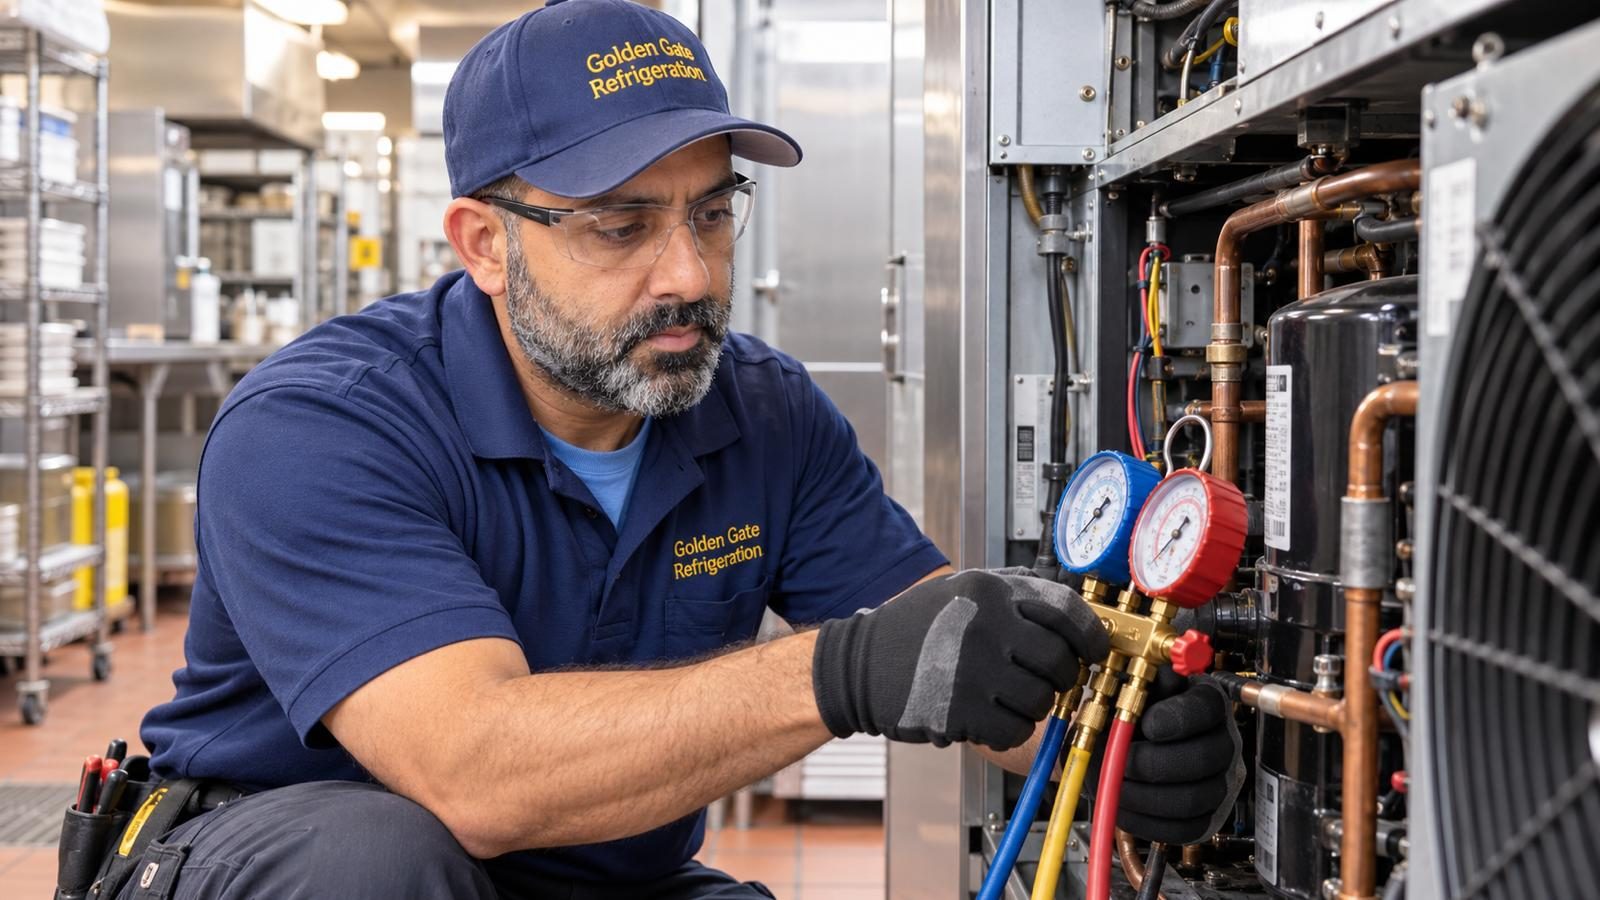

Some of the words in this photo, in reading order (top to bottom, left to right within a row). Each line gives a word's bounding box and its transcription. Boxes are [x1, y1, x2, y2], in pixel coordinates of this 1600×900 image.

[586, 41, 659, 74] Golden
[659, 37, 695, 61] Gate
[588, 60, 707, 100] Refrigeration
[674, 534, 726, 558] Golden
[727, 524, 761, 544] Gate
[673, 545, 764, 580] Refrigeration
